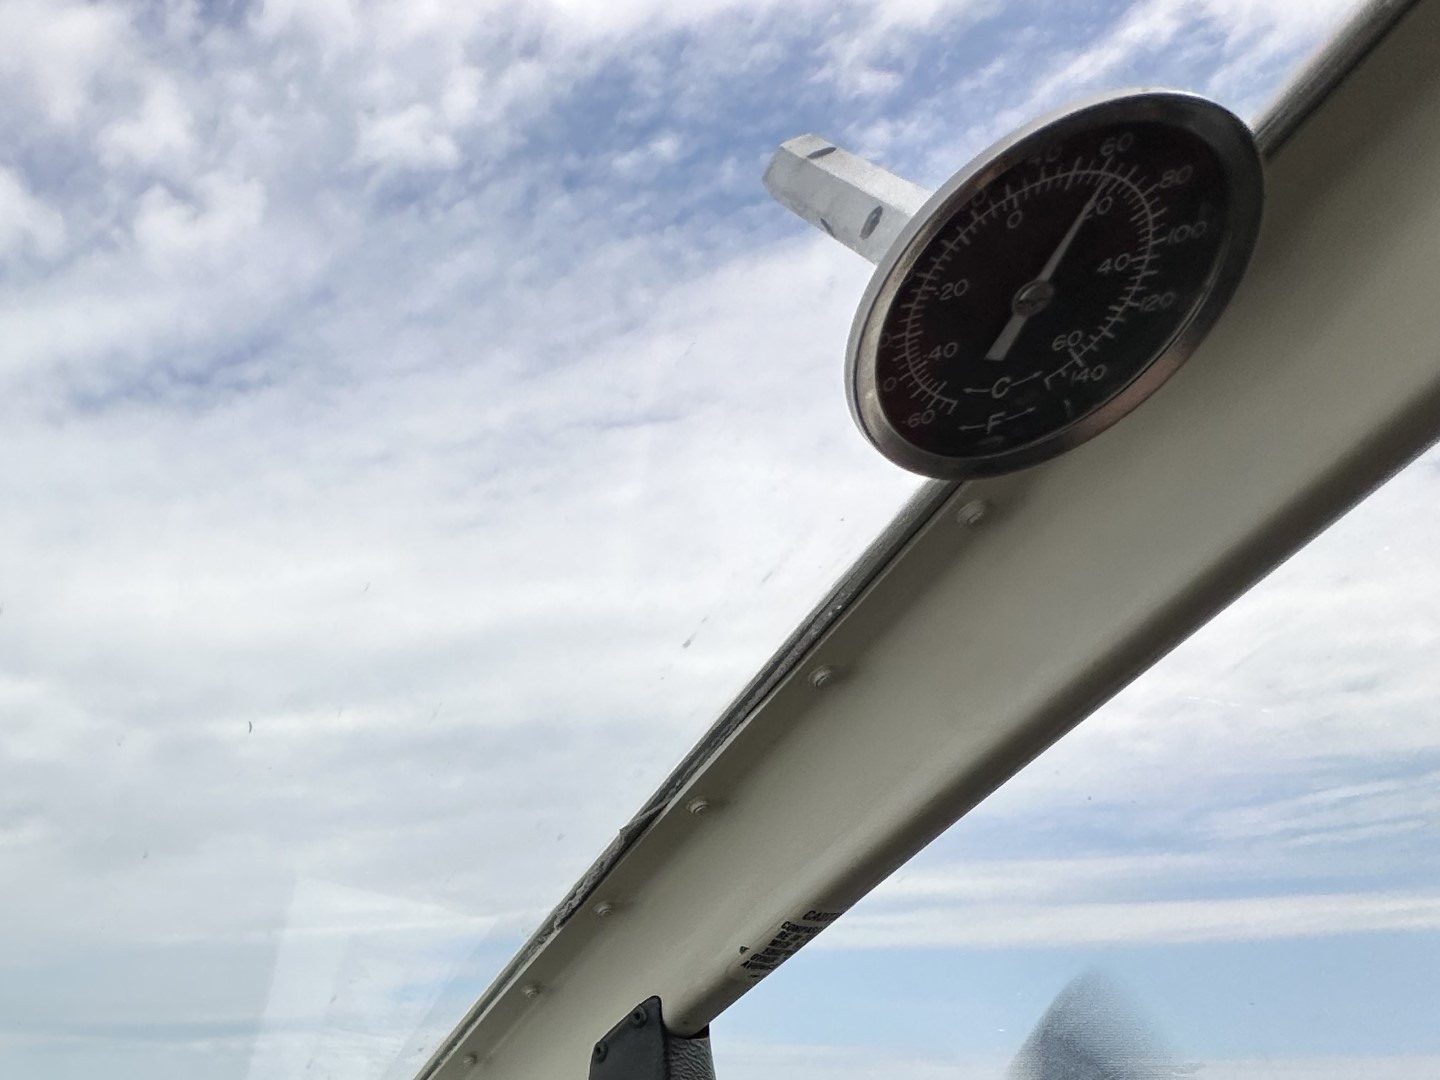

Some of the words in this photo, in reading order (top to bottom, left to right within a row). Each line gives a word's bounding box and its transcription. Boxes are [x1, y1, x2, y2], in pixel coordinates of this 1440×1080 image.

[1100, 134, 1134, 156] 60
[1158, 165, 1193, 189] 80
[1006, 211, 1024, 230] 0
[1166, 221, 1208, 244] 100
[1096, 255, 1130, 274] 40
[1052, 332, 1082, 352] 60
[991, 377, 1011, 398] C
[986, 413, 1005, 435] F
